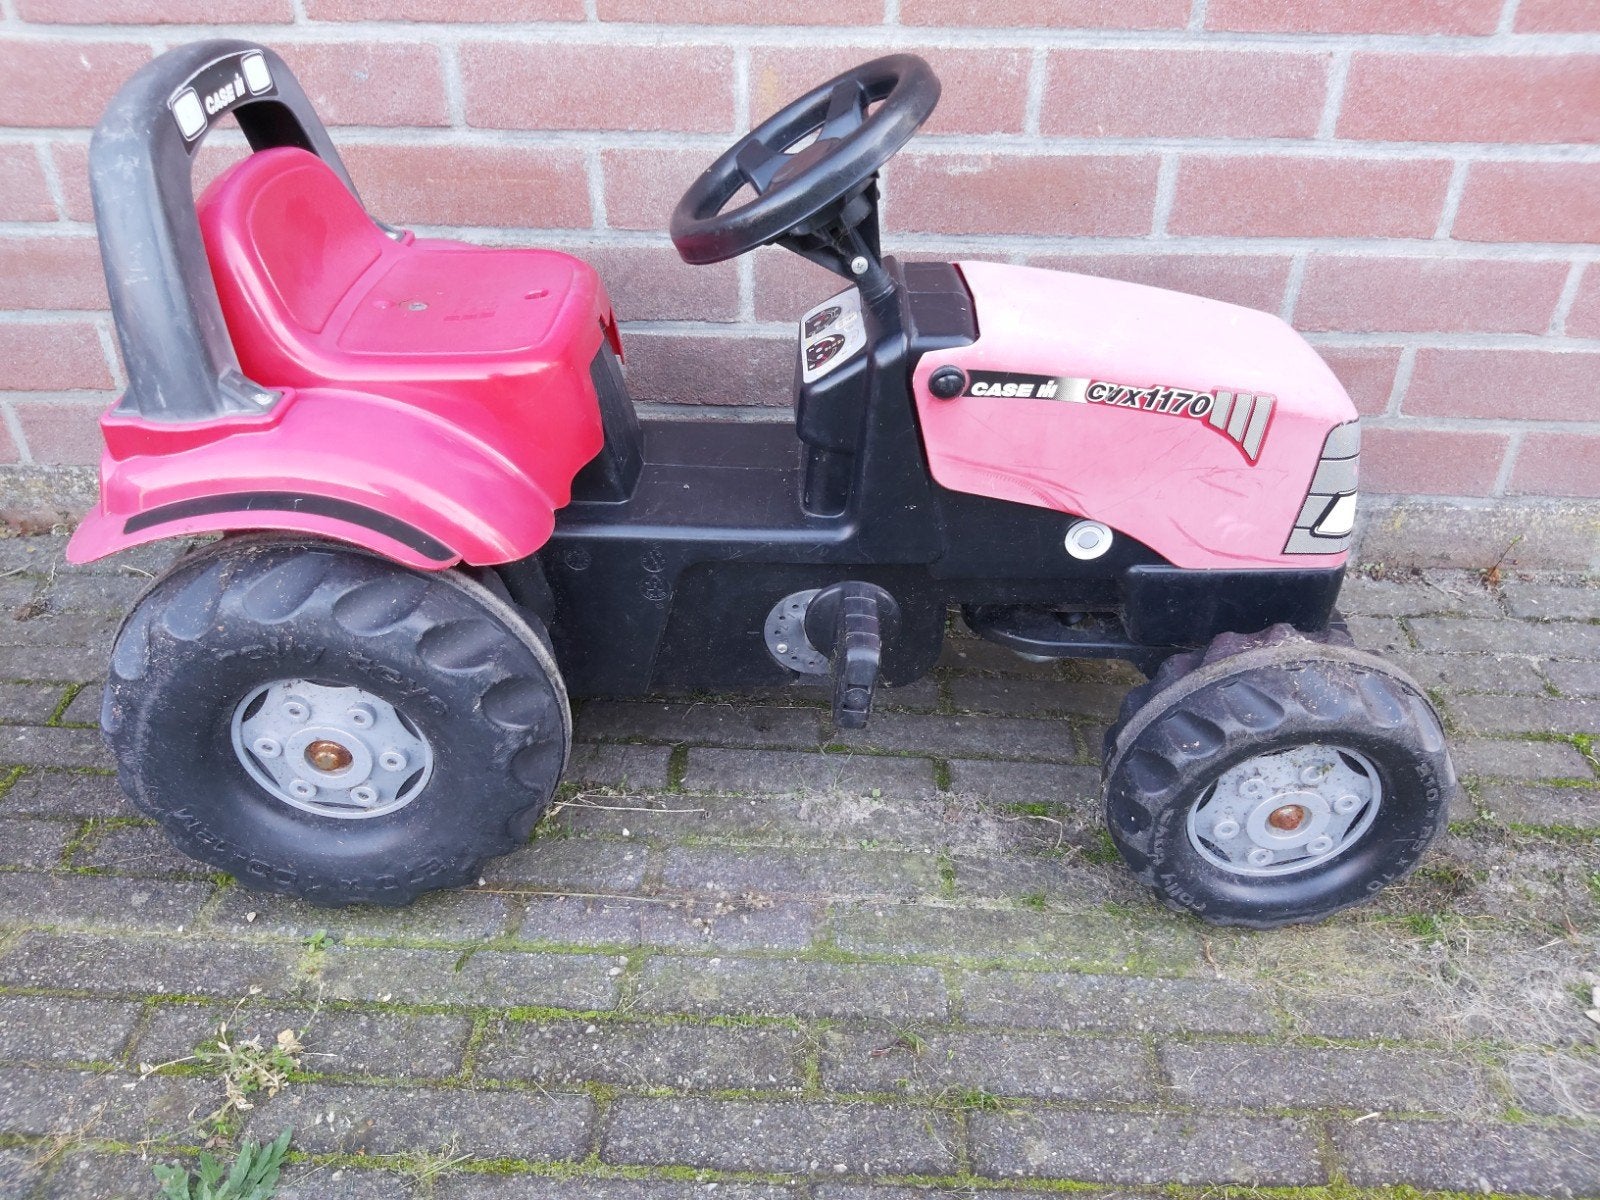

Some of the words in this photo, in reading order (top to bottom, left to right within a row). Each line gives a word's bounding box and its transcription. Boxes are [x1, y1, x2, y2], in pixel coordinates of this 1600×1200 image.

[205, 83, 235, 115] CASE
[971, 381, 1034, 398] CASE
[1086, 381, 1214, 418] CVX1170
